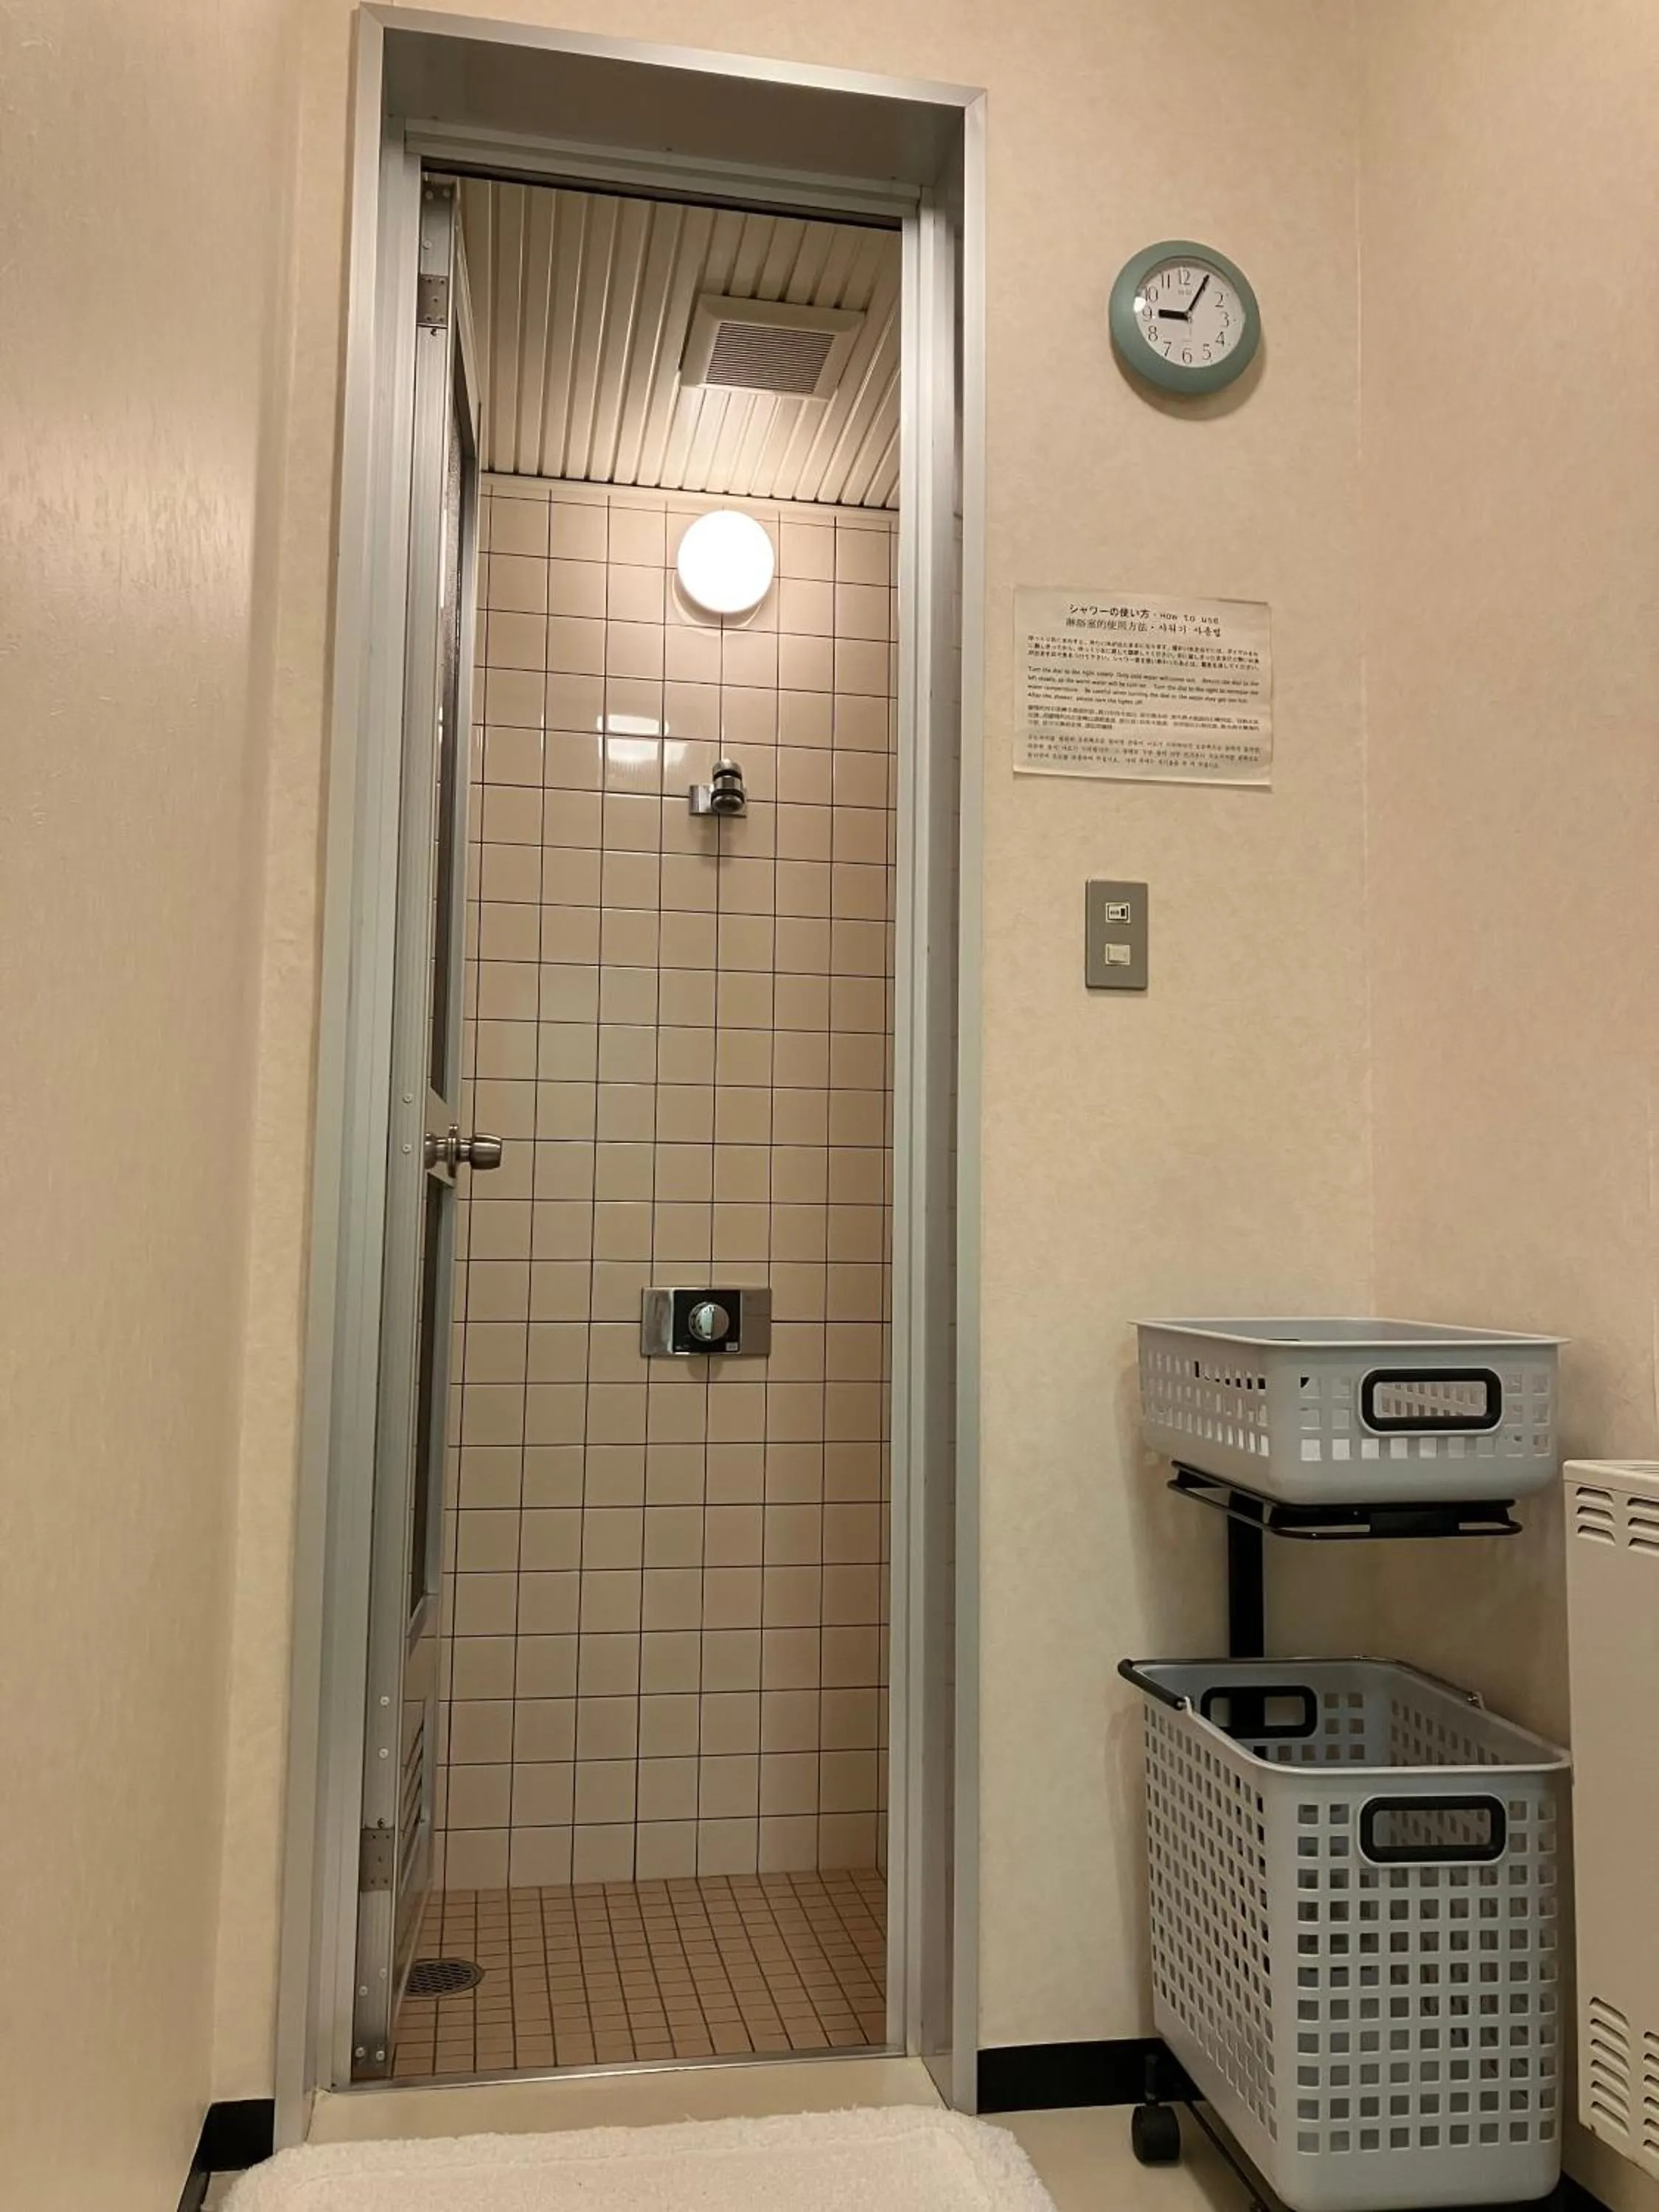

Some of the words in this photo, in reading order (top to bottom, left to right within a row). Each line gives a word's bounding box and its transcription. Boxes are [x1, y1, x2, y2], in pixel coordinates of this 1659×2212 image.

[1161, 274, 1170, 290] 11
[1178, 270, 1191, 285] 12
[1145, 286, 1158, 302] 10
[1214, 291, 1224, 307] 2
[1142, 305, 1152, 322] 9
[1220, 311, 1229, 327] 3
[1148, 326, 1158, 342] 8
[1214, 331, 1225, 347] 4
[1163, 341, 1172, 357] 7
[1182, 348, 1192, 364] 6
[1203, 344, 1211, 361] 5
